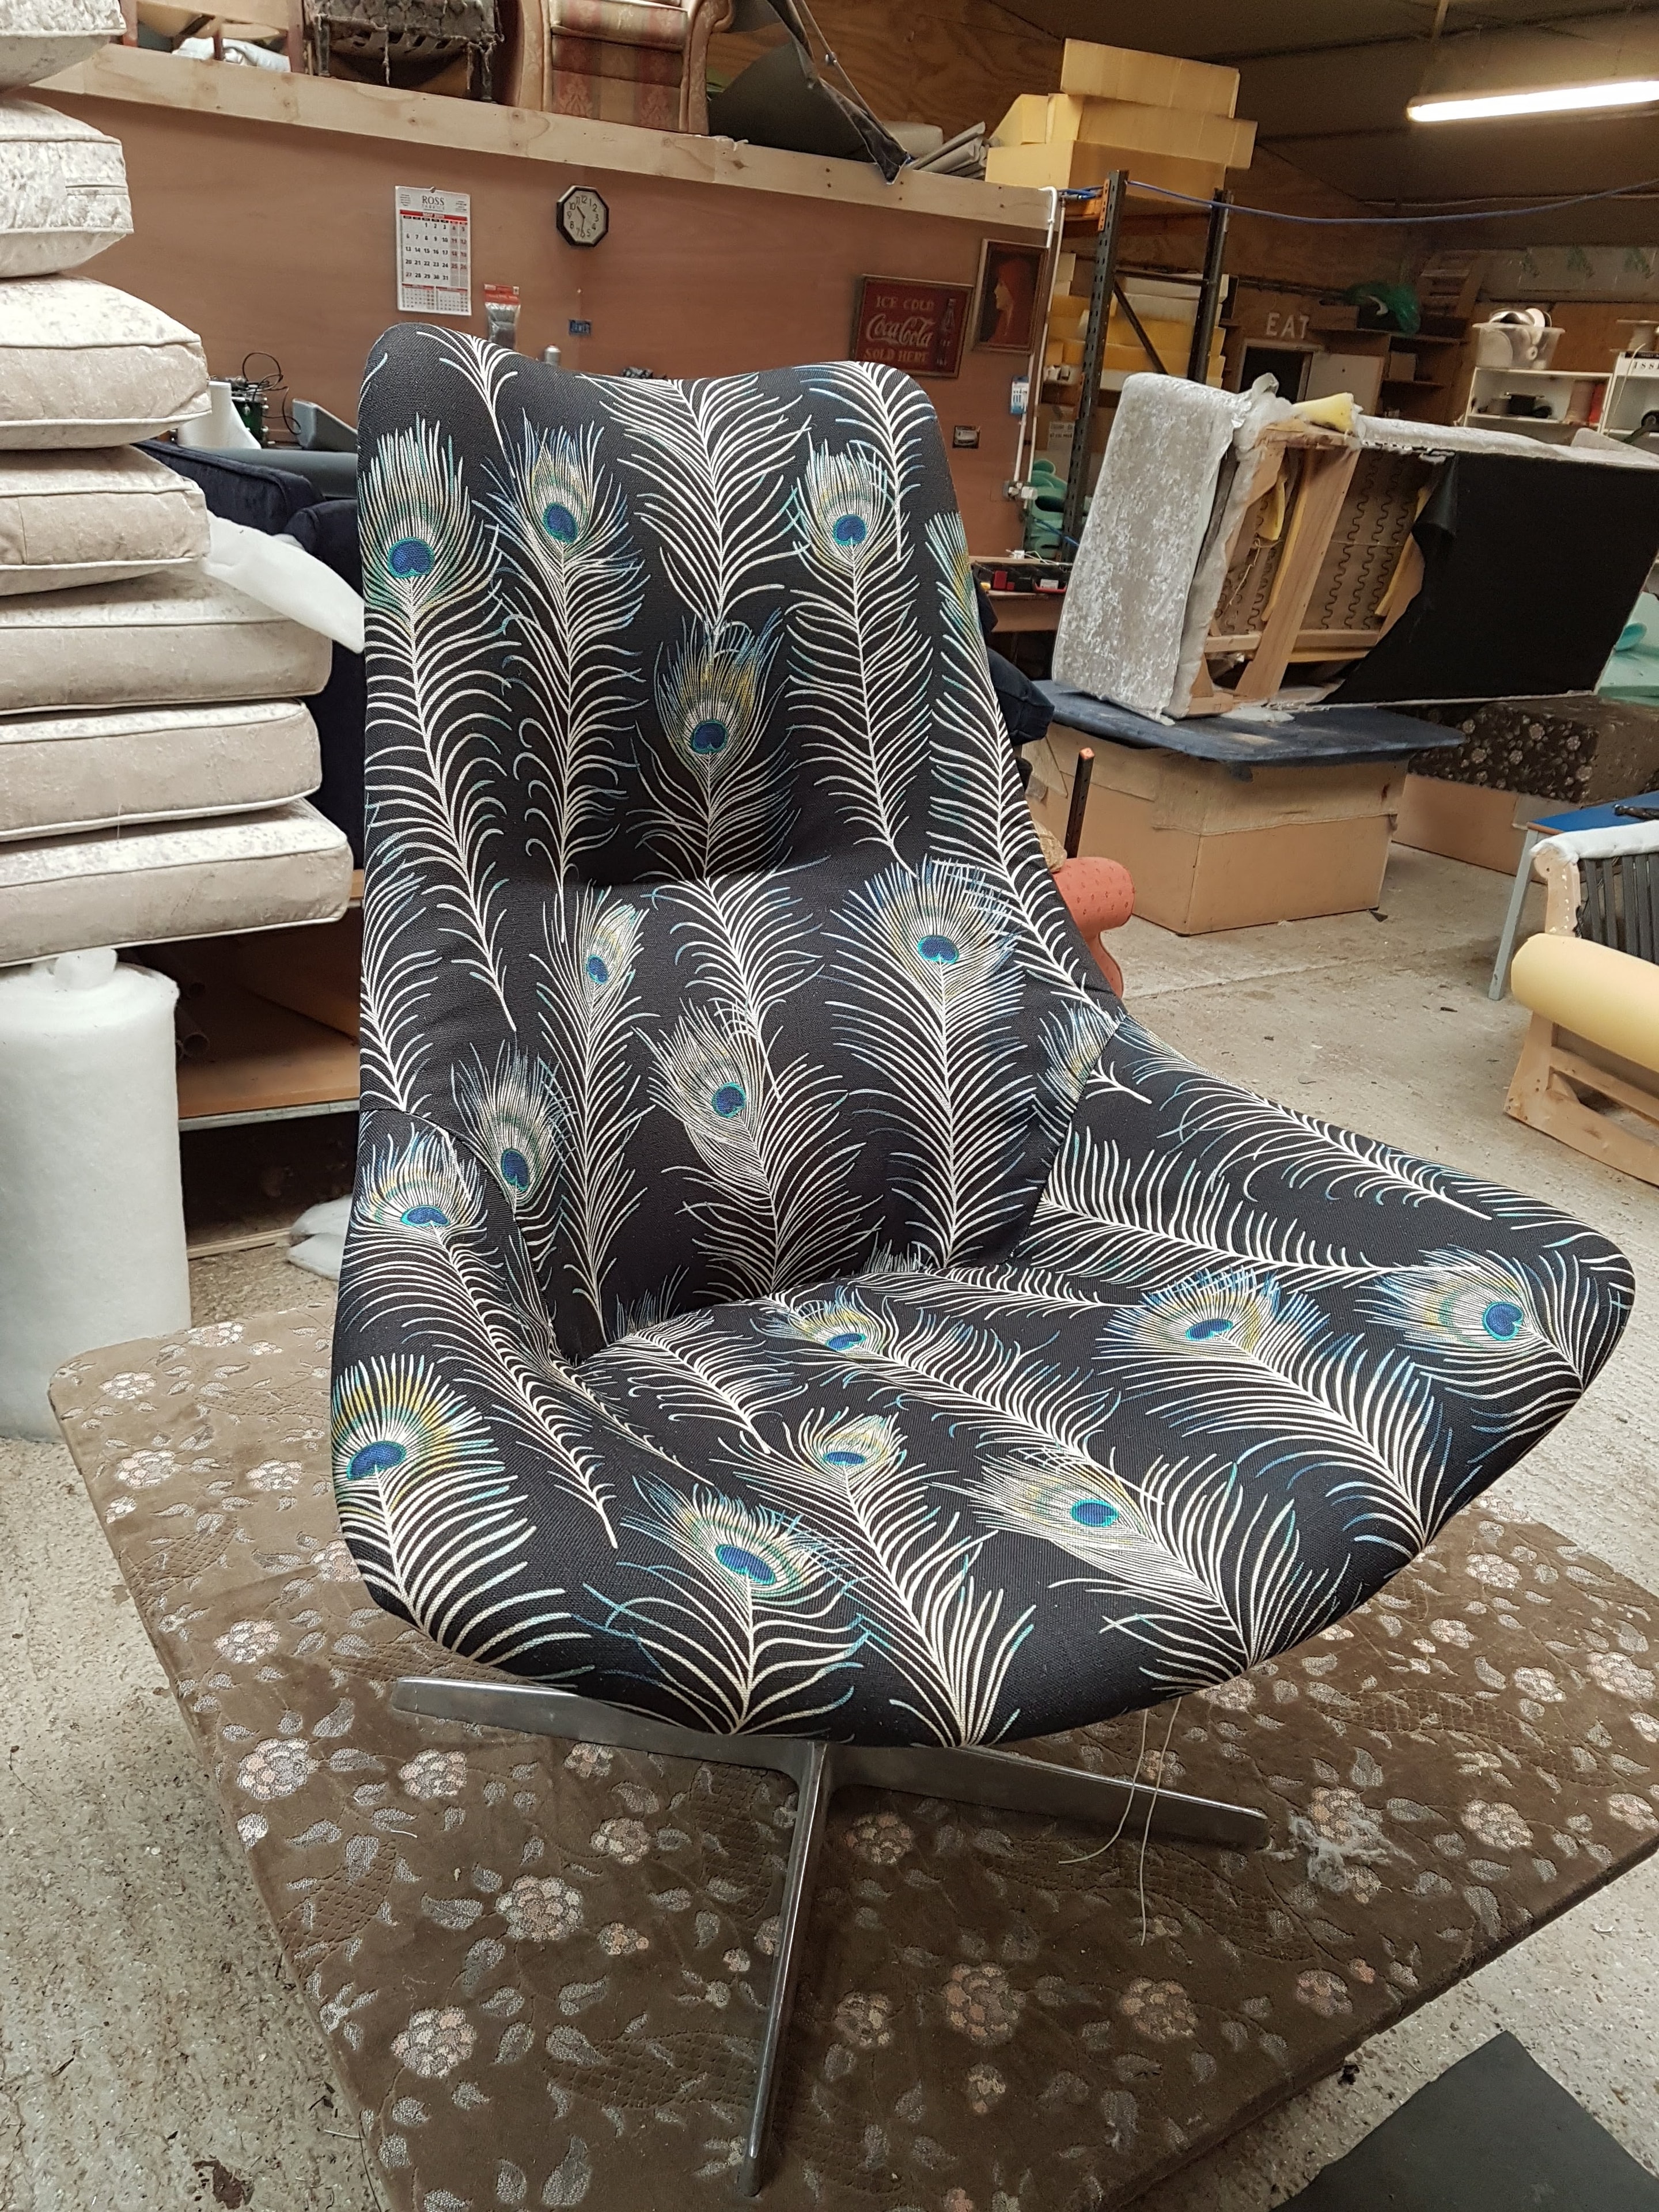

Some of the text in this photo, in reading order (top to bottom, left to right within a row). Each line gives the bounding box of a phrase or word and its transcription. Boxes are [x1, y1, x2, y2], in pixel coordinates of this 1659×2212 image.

[422, 195, 445, 206] ROSS
[581, 195, 588, 204] 12
[590, 198, 592, 207] 1
[570, 202, 576, 210] 10
[593, 203, 597, 212] 2
[567, 211, 572, 219] 9
[596, 214, 599, 222] 3
[570, 221, 574, 229] 8
[576, 228, 580, 236] 7
[587, 229, 590, 237] 5
[876, 295, 934, 311] ICE COLD
[1266, 312, 1310, 339] EAT
[864, 347, 895, 361] SOLD
